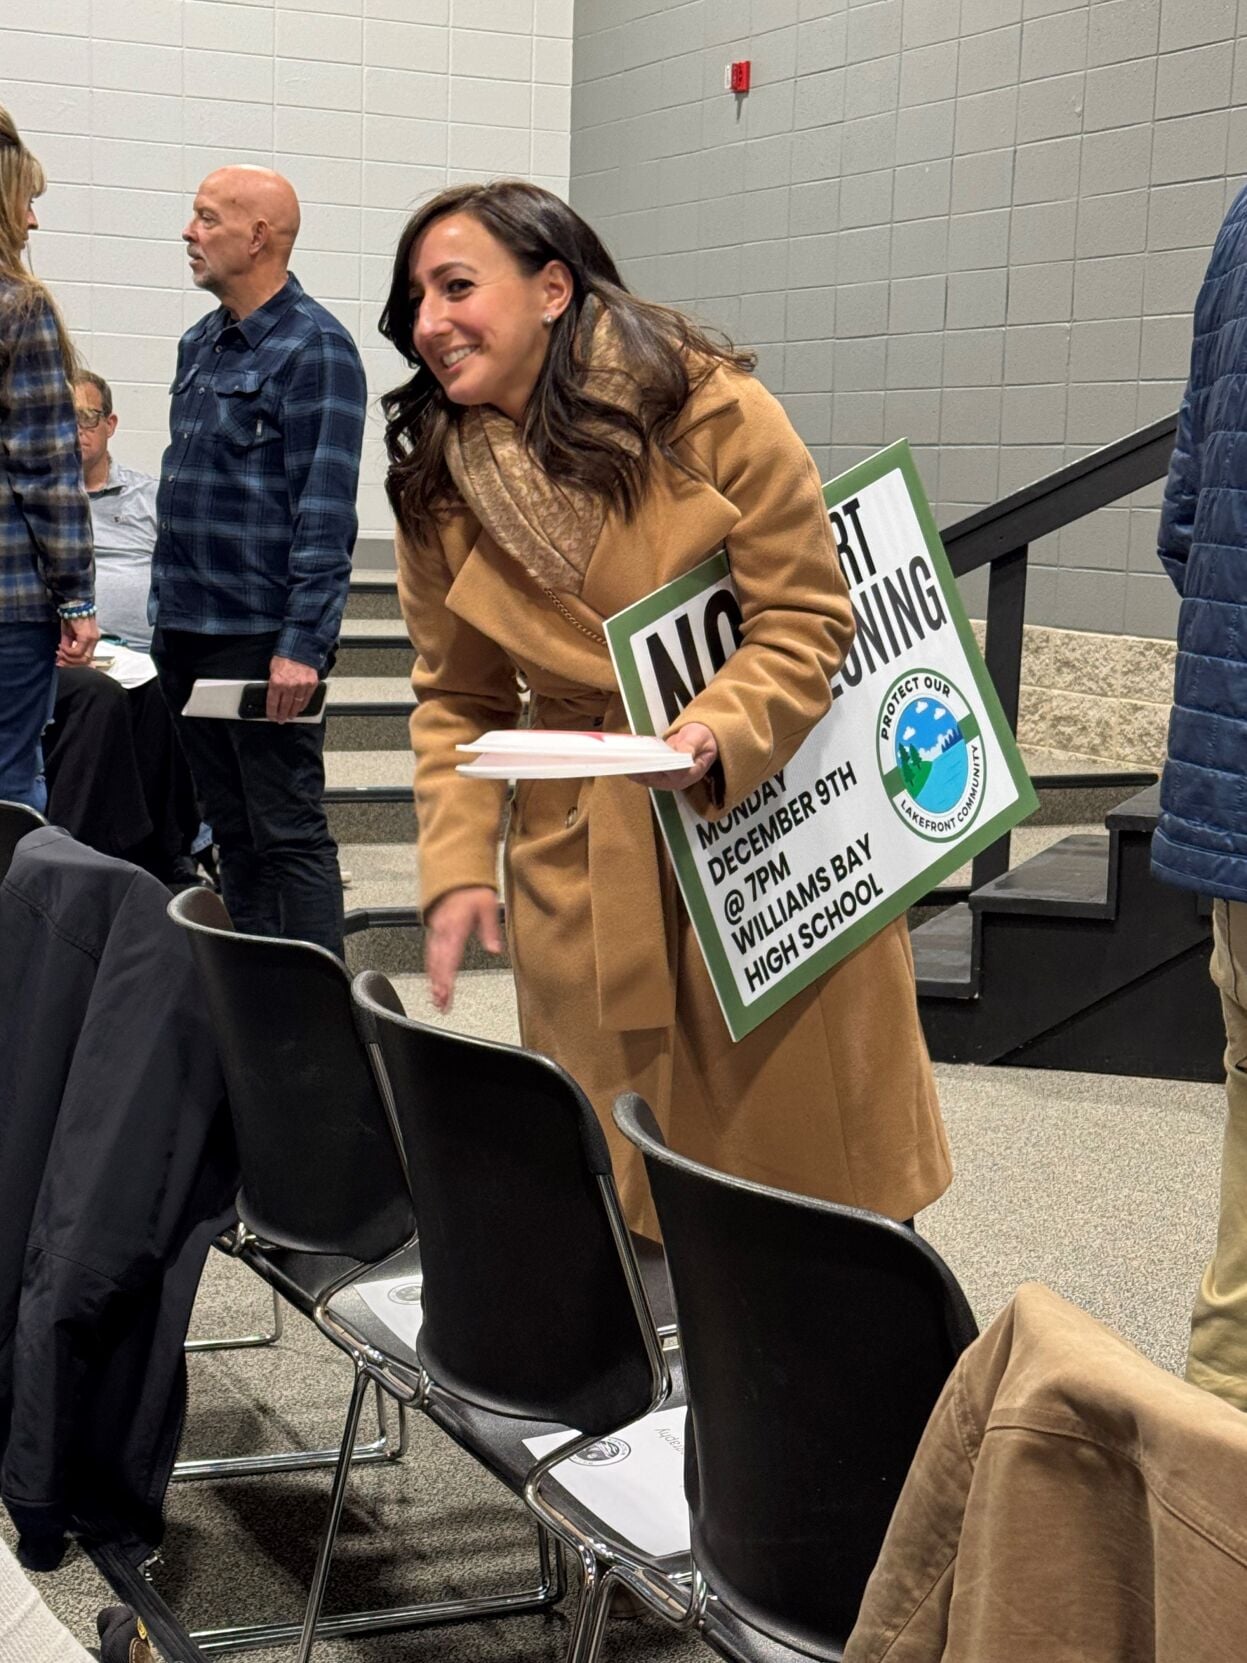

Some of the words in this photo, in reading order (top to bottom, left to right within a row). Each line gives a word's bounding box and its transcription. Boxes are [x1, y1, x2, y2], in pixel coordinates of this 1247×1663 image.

[881, 677, 919, 741] PROTECT
[924, 676, 951, 698] OUR
[707, 791, 817, 887] DECEMBER
[814, 760, 858, 806] 9TH
[901, 800, 956, 832] LAKEFRONT
[957, 745, 981, 823] COMMUNITY
[724, 889, 745, 926] @
[743, 851, 792, 902] 7PM
[731, 866, 832, 956] WILLIAMS
[829, 832, 872, 883] BAY
[744, 933, 800, 993] HIGH
[798, 873, 884, 949] SCHOOL
